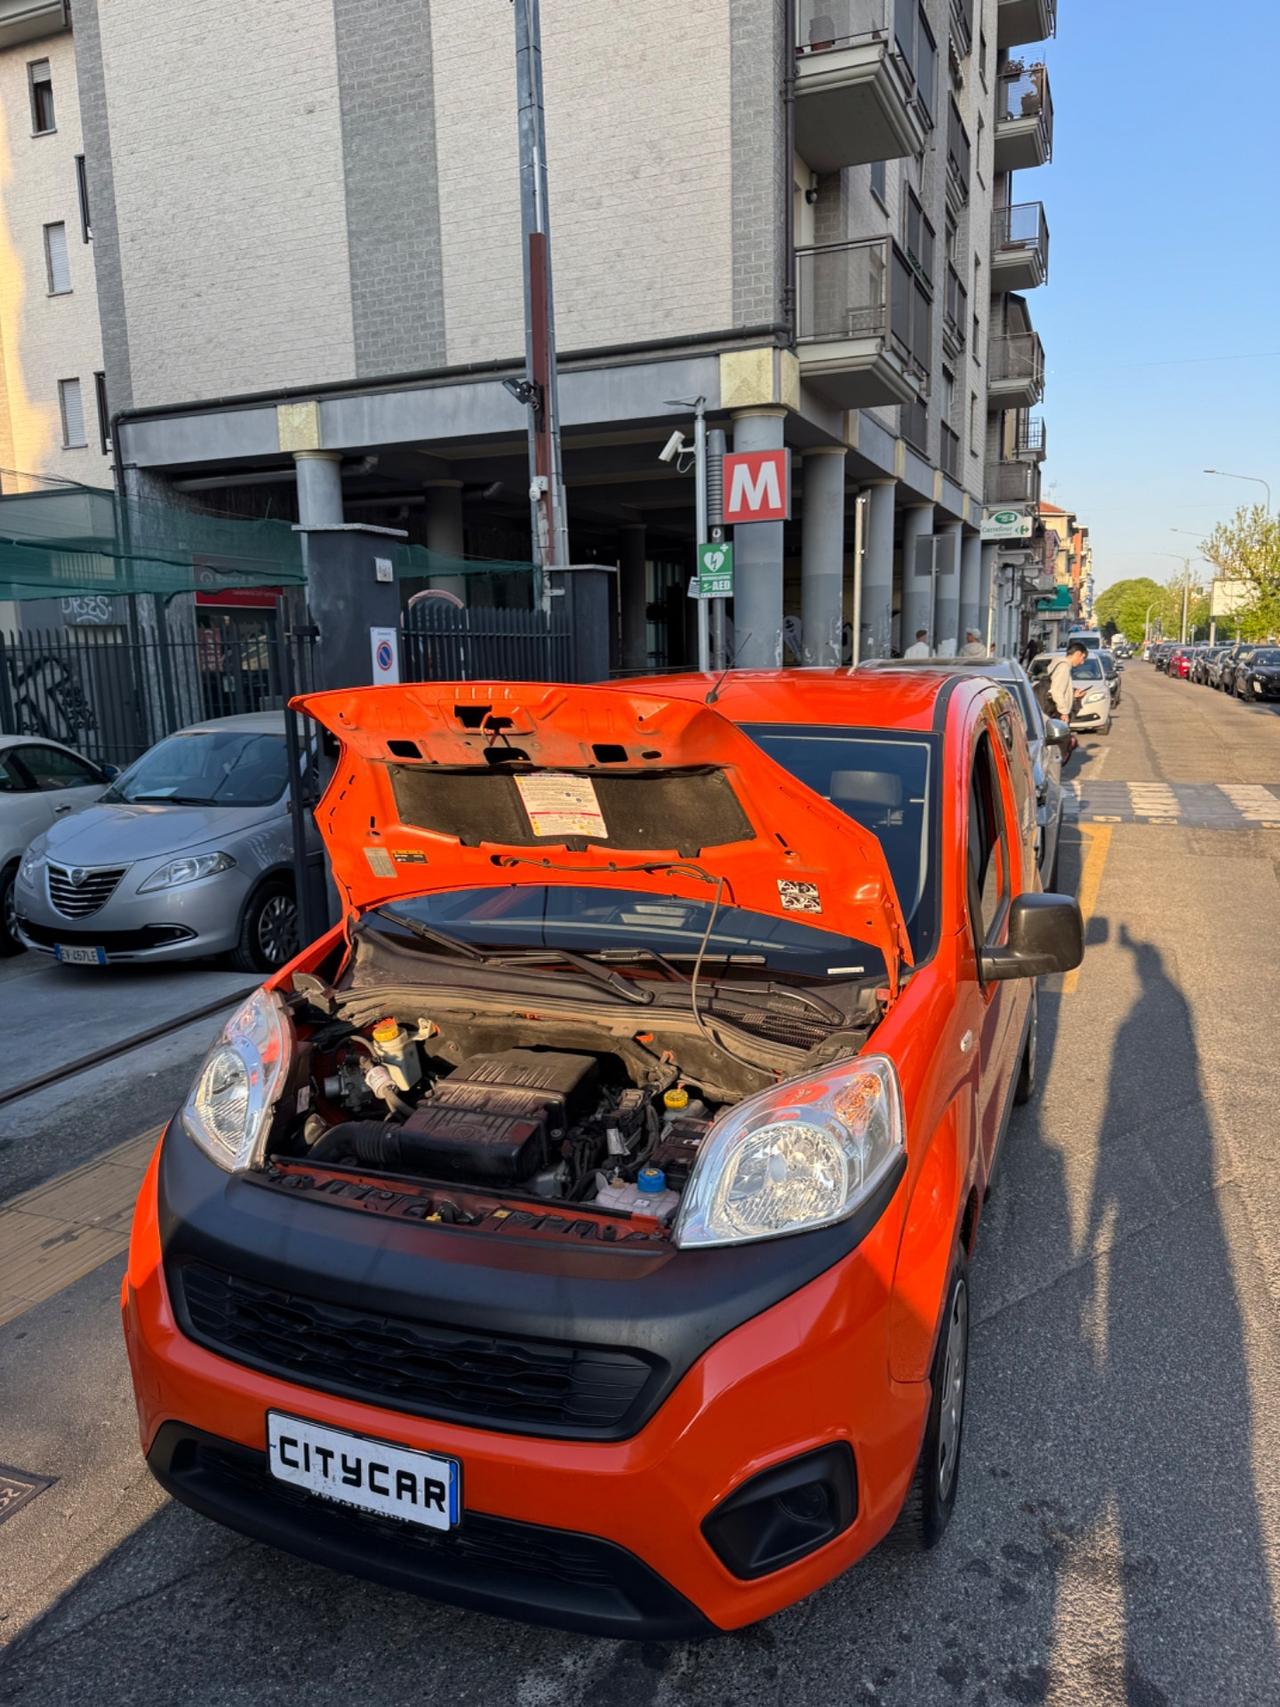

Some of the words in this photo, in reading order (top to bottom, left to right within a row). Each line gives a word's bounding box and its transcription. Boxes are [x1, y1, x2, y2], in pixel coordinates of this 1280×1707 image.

[728, 461, 782, 513] M
[712, 580, 731, 591] AED
[279, 1435, 446, 1514] CITYCAR
